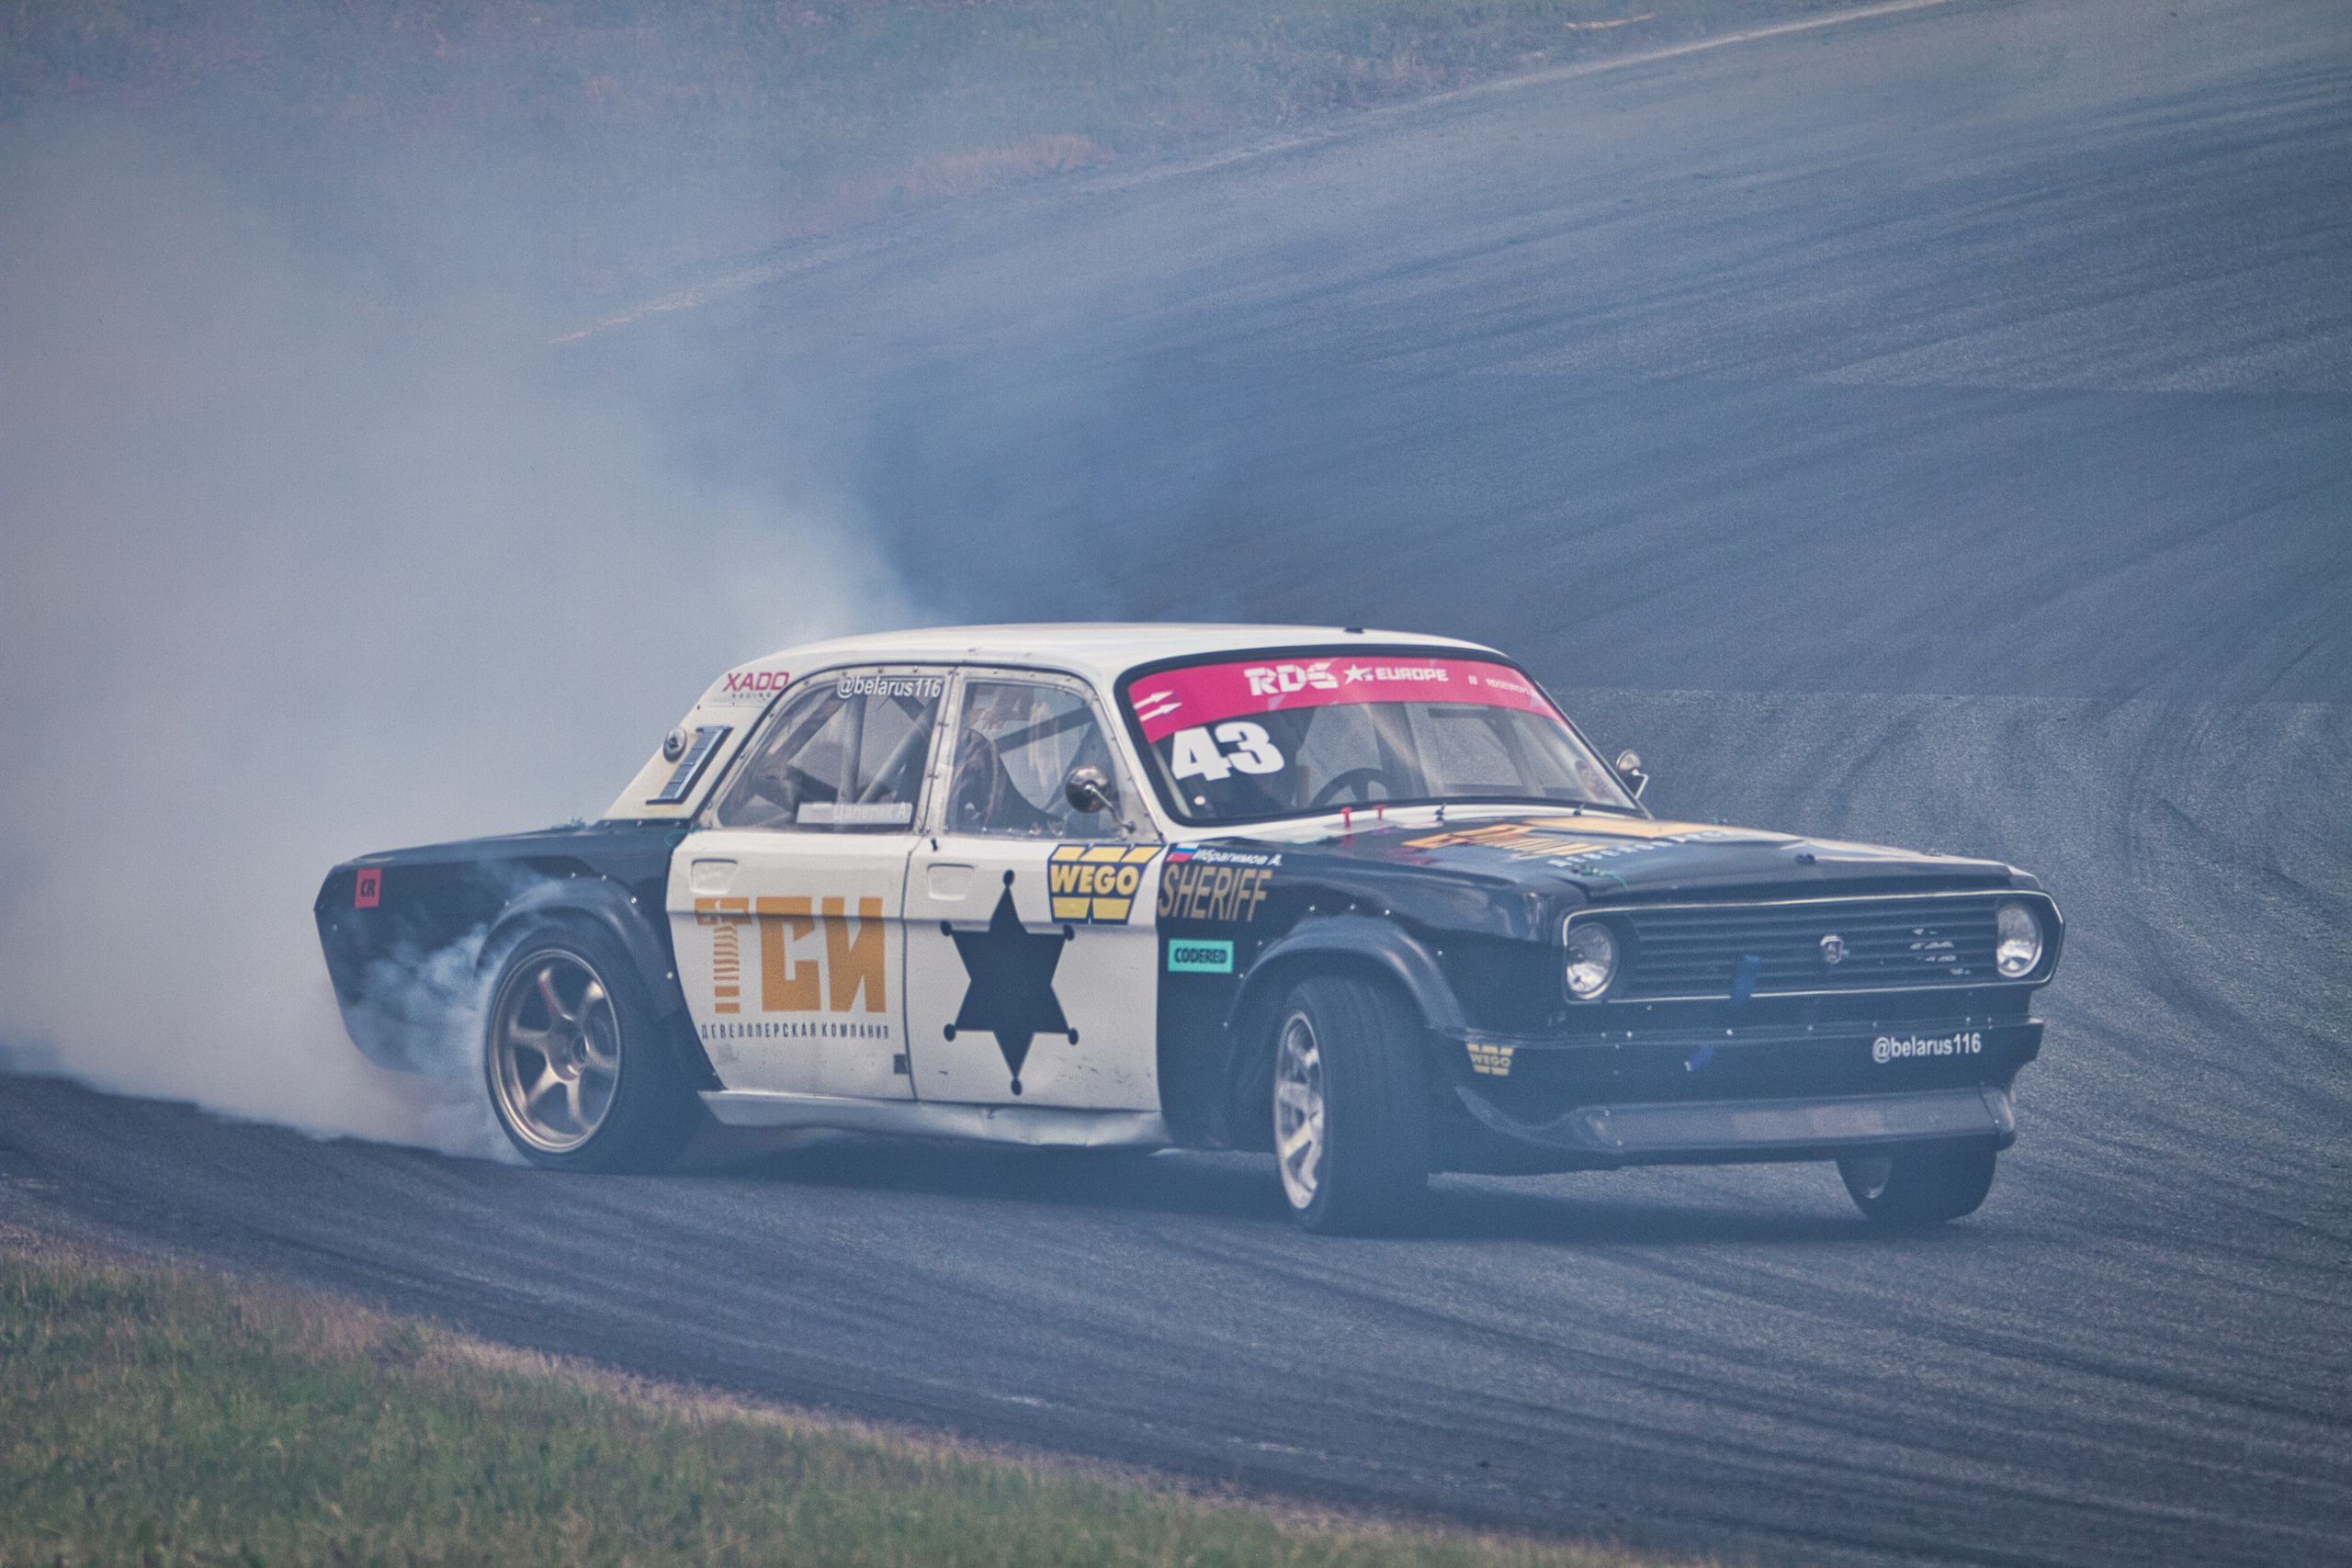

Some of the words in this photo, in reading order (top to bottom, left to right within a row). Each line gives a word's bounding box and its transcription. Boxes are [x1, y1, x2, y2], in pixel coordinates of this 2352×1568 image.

[723, 671, 790, 692] XADO
[837, 676, 943, 699] @belarus116
[1243, 662, 1340, 696] RDS
[1375, 667, 1449, 682] EUROPE
[1171, 721, 1285, 782] 43
[360, 878, 377, 897] CR
[1050, 863, 1140, 896] WEGO
[1158, 863, 1273, 922] SHERIFF
[1174, 947, 1229, 964] CODERED
[701, 1021, 817, 1040] ДЕВЕЛОПЕРСКАЯ
[820, 1022, 889, 1040] КОМПАНИЯ
[1871, 1032, 1982, 1064] @belarus116
